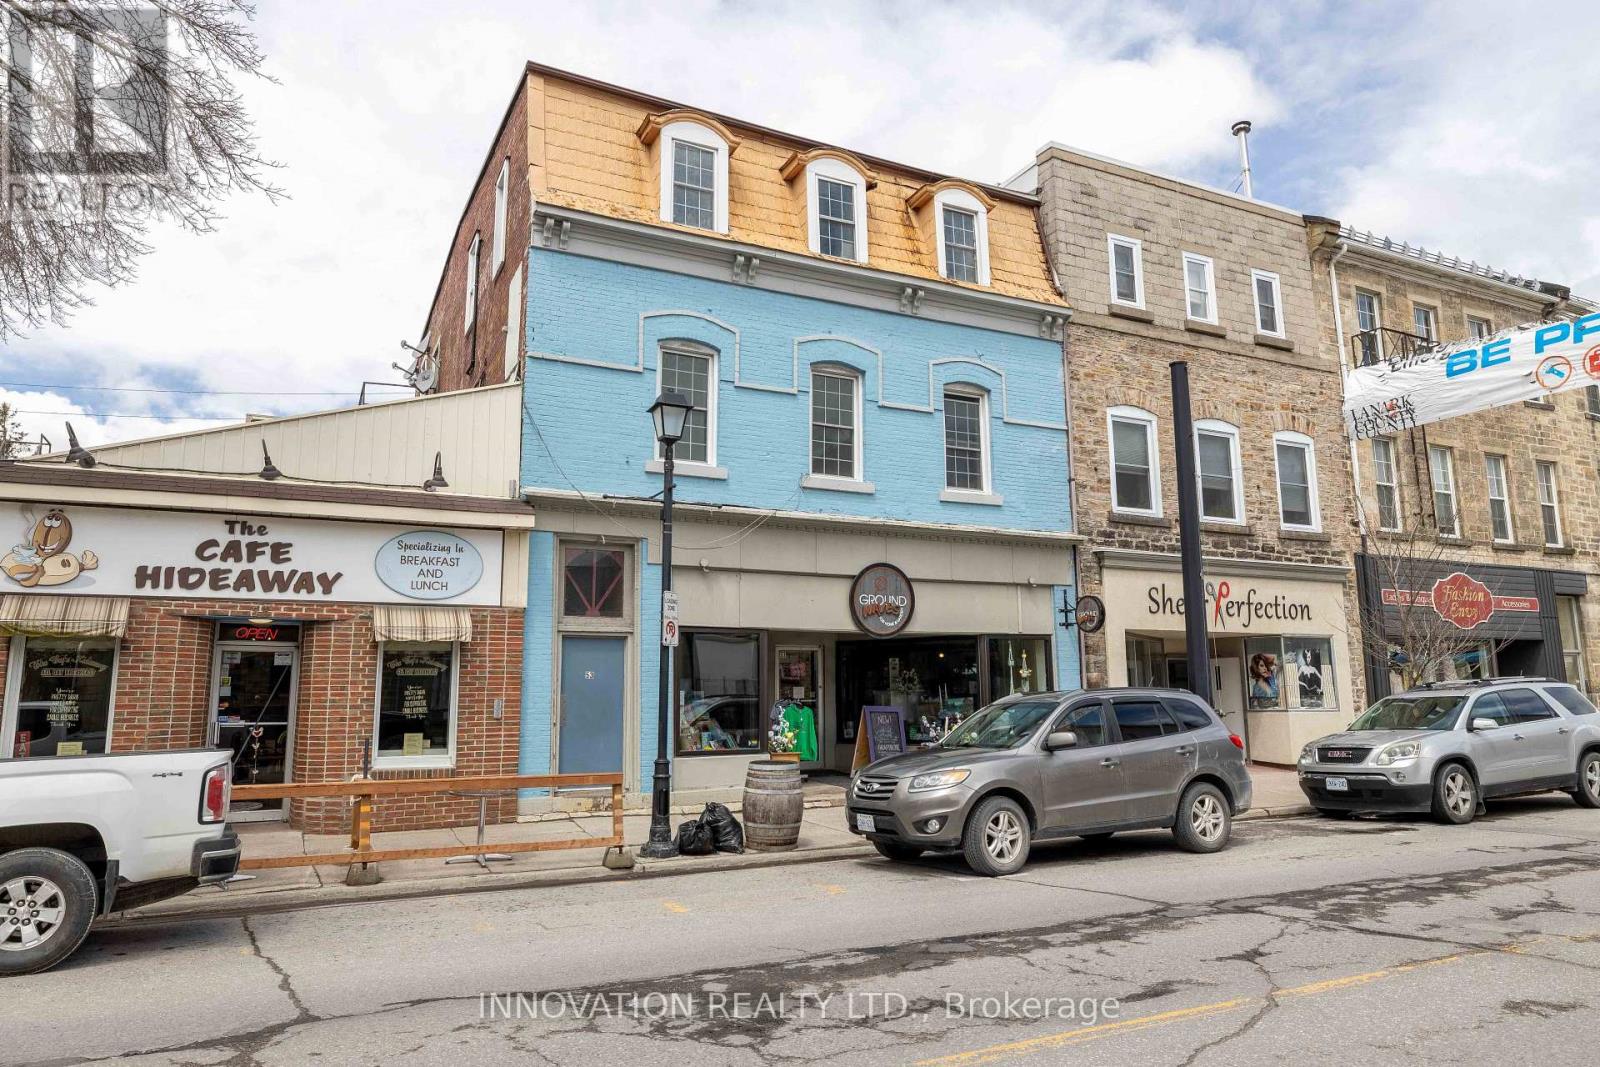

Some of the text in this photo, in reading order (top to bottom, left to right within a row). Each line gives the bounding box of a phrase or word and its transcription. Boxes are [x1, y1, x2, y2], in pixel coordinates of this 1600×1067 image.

[1446, 337, 1512, 379] BE
[224, 520, 269, 536] The
[195, 539, 293, 564] CAFE
[397, 540, 464, 554] Specializing In
[400, 555, 460, 567] BREAKFAST
[135, 566, 343, 595] HIDEAWAY
[417, 569, 443, 579] AND
[411, 581, 448, 591] LUNCH
[859, 594, 907, 607] GROUND
[1443, 585, 1485, 603] Fashion
[236, 627, 278, 640] OPEN
